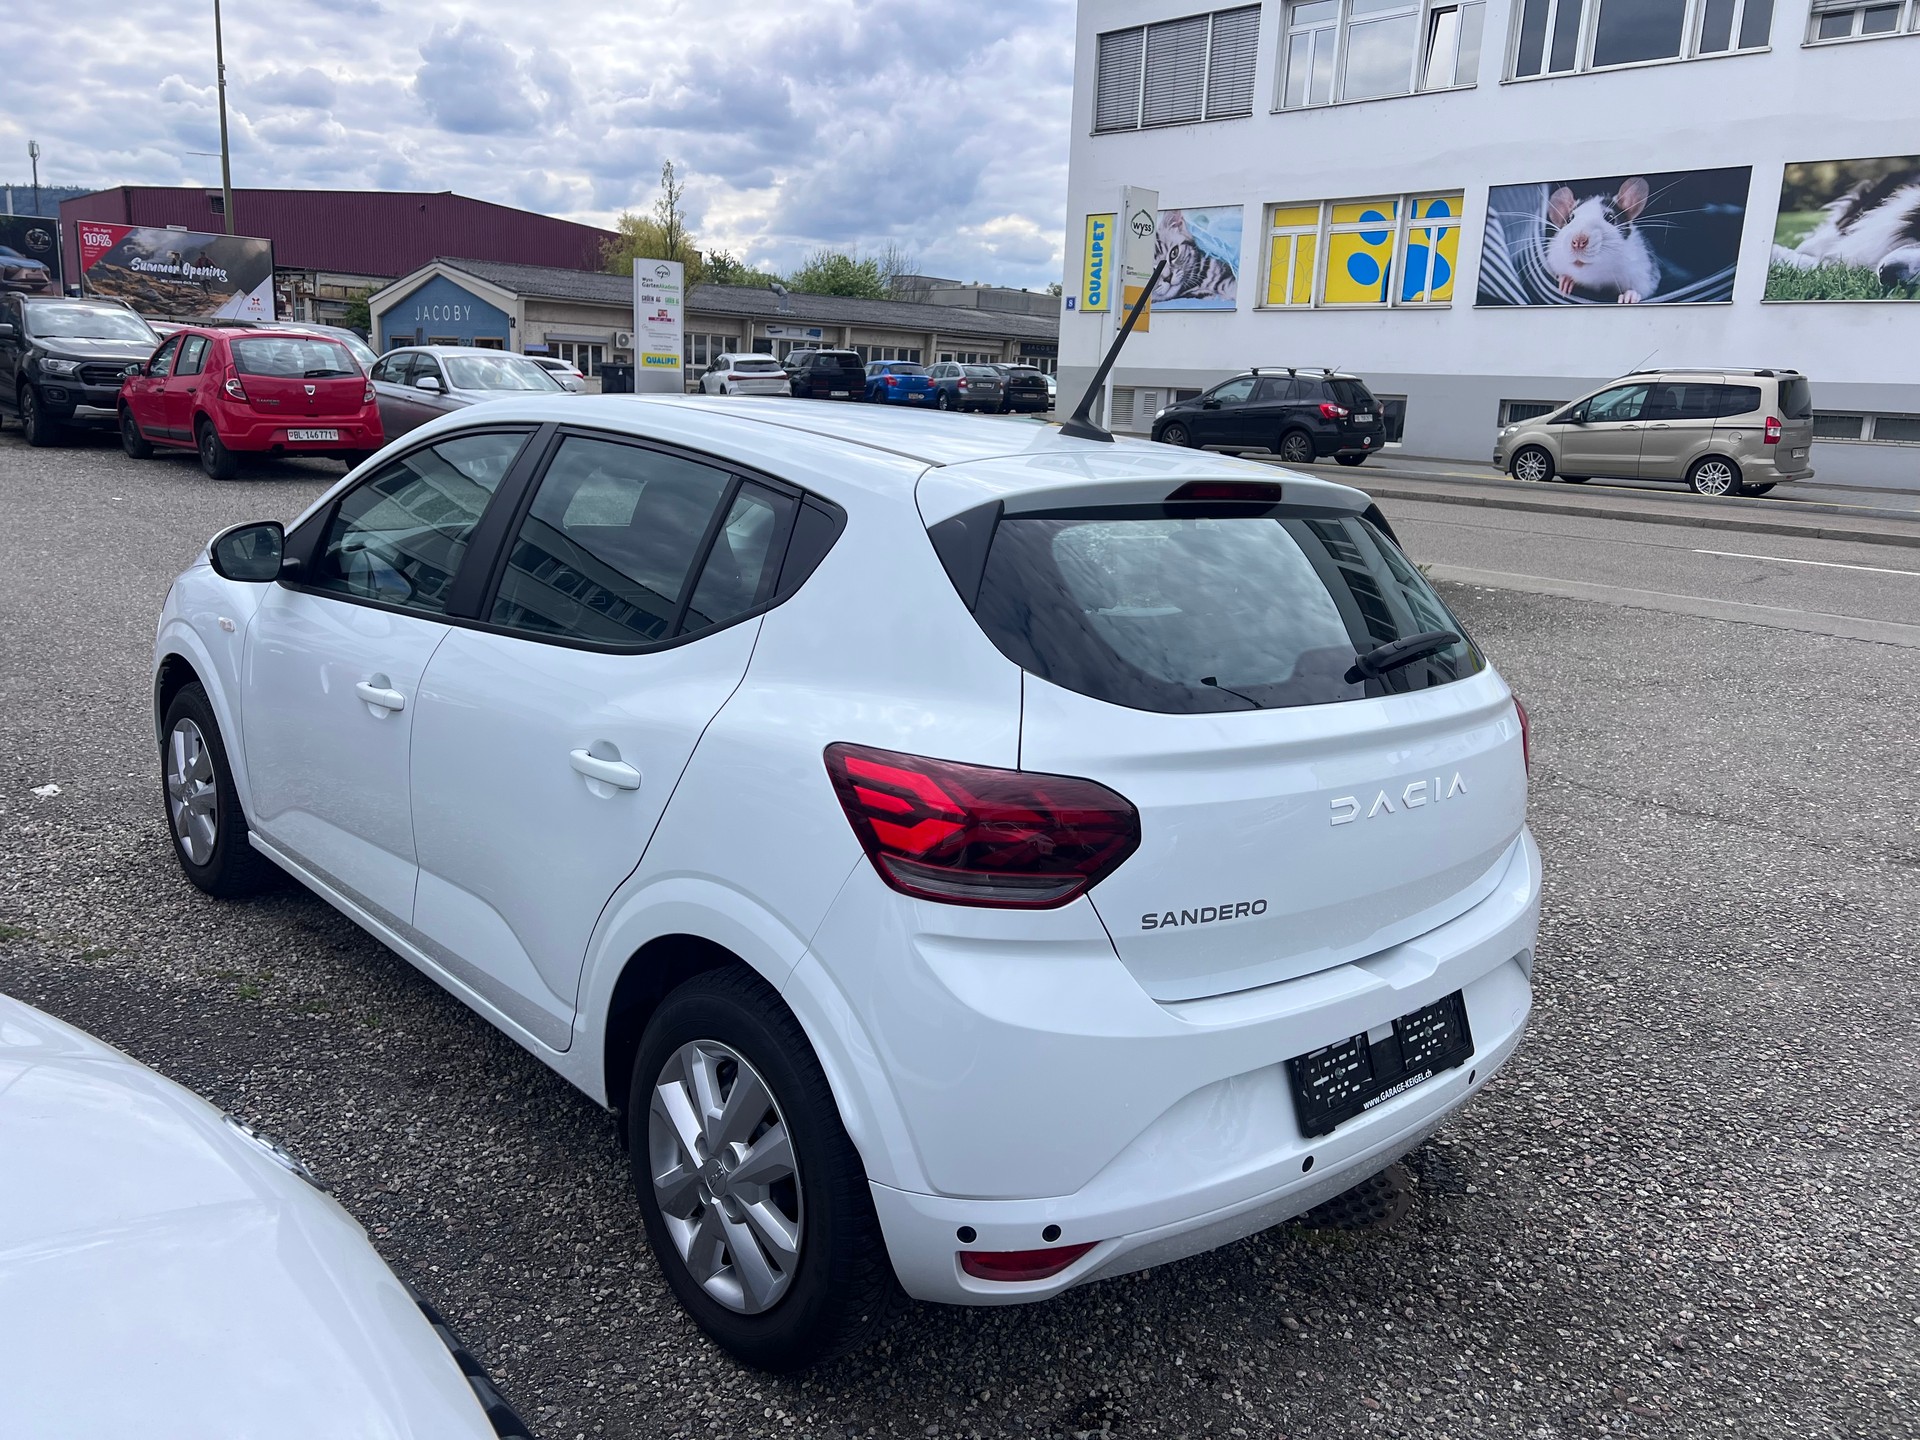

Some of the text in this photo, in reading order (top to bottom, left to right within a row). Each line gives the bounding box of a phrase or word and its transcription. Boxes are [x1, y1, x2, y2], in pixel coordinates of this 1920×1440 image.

[83, 232, 112, 247] 10%
[1132, 220, 1152, 239] wyss
[131, 257, 228, 282] Summer Opening
[1088, 220, 1105, 306] QUALIPET
[415, 305, 471, 321] JACOBY
[646, 356, 677, 365] QUALIPET
[1330, 771, 1468, 827] DACIA
[1141, 899, 1268, 930] SANDERO
[1362, 1068, 1433, 1110] www.GARAGE-KEIGEL.ch
